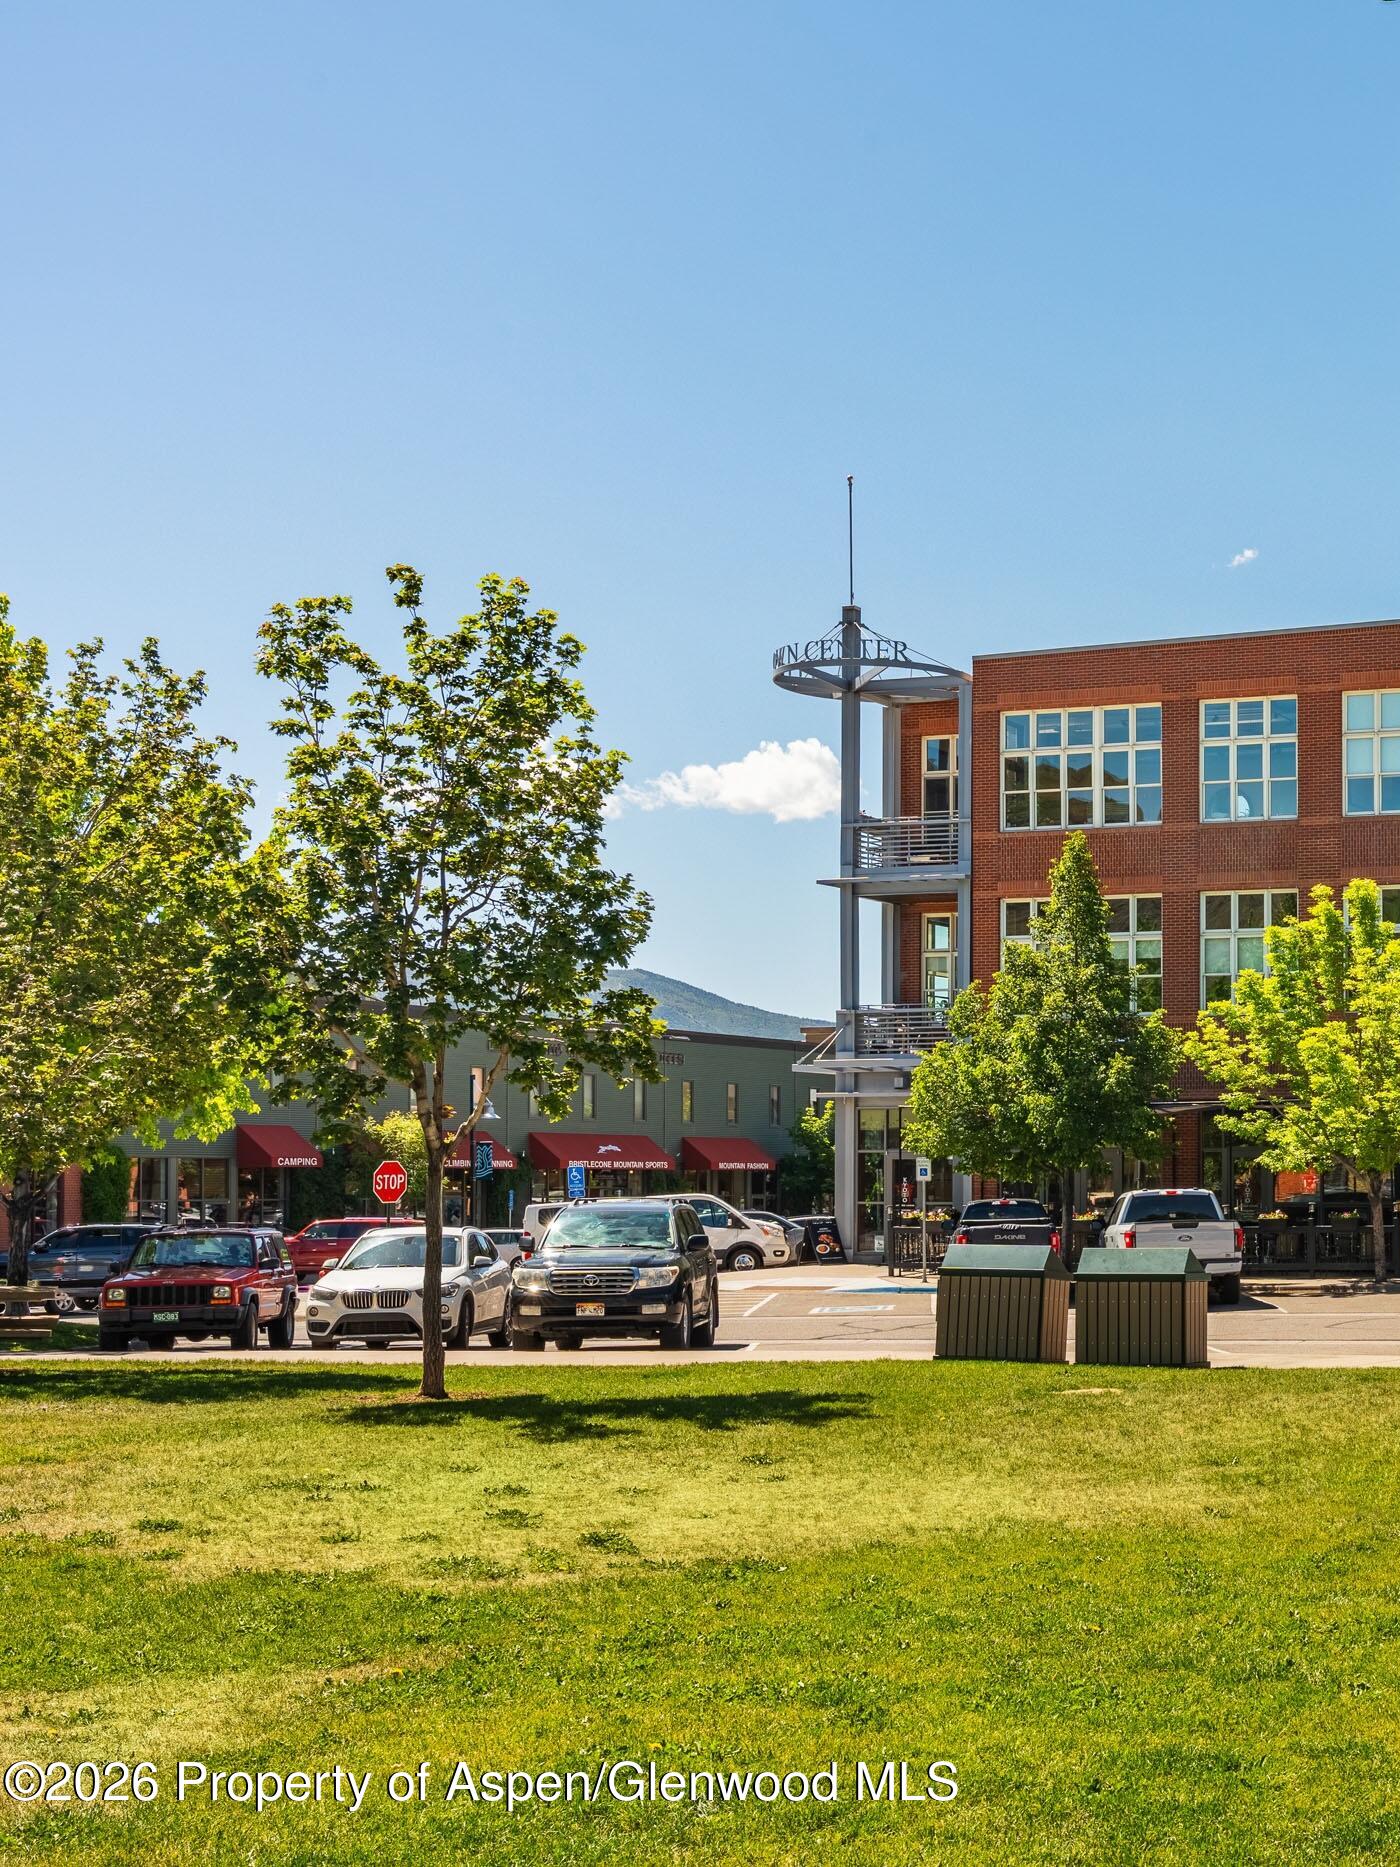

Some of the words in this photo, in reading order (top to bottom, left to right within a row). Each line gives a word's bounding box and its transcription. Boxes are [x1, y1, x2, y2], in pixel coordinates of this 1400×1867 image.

[277, 1157, 318, 1167] CAMPING
[568, 1160, 612, 1169] BRISTLECONE
[613, 1161, 644, 1169] MOUNTAIN
[645, 1161, 669, 1169] SPORTS
[718, 1162, 746, 1170] MOUNTAIN
[746, 1162, 769, 1170] FASHION
[375, 1174, 406, 1191] STOP
